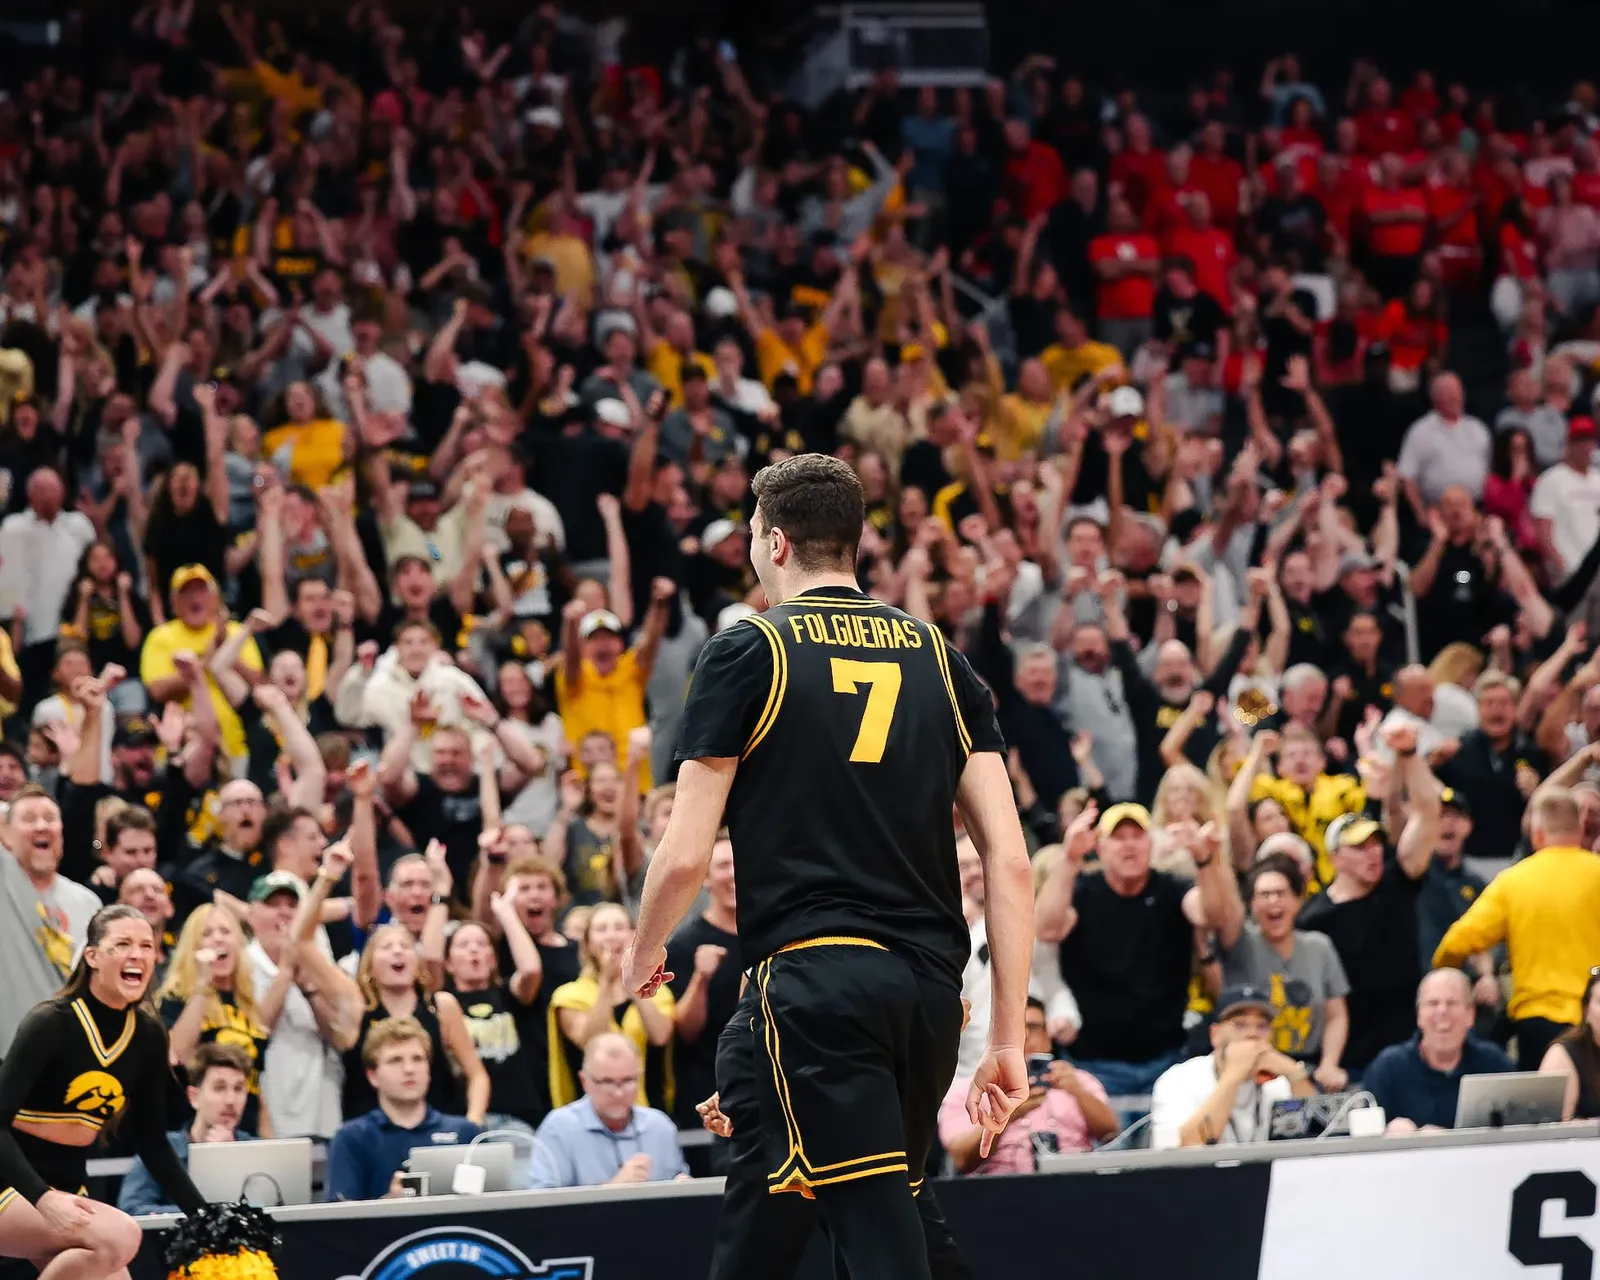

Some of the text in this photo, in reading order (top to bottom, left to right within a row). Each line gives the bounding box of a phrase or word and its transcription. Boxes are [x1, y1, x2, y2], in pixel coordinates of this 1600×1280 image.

[788, 614, 922, 648] FOLGUEIRAS
[830, 657, 902, 763] 7
[406, 1242, 481, 1269] SWEET 16
